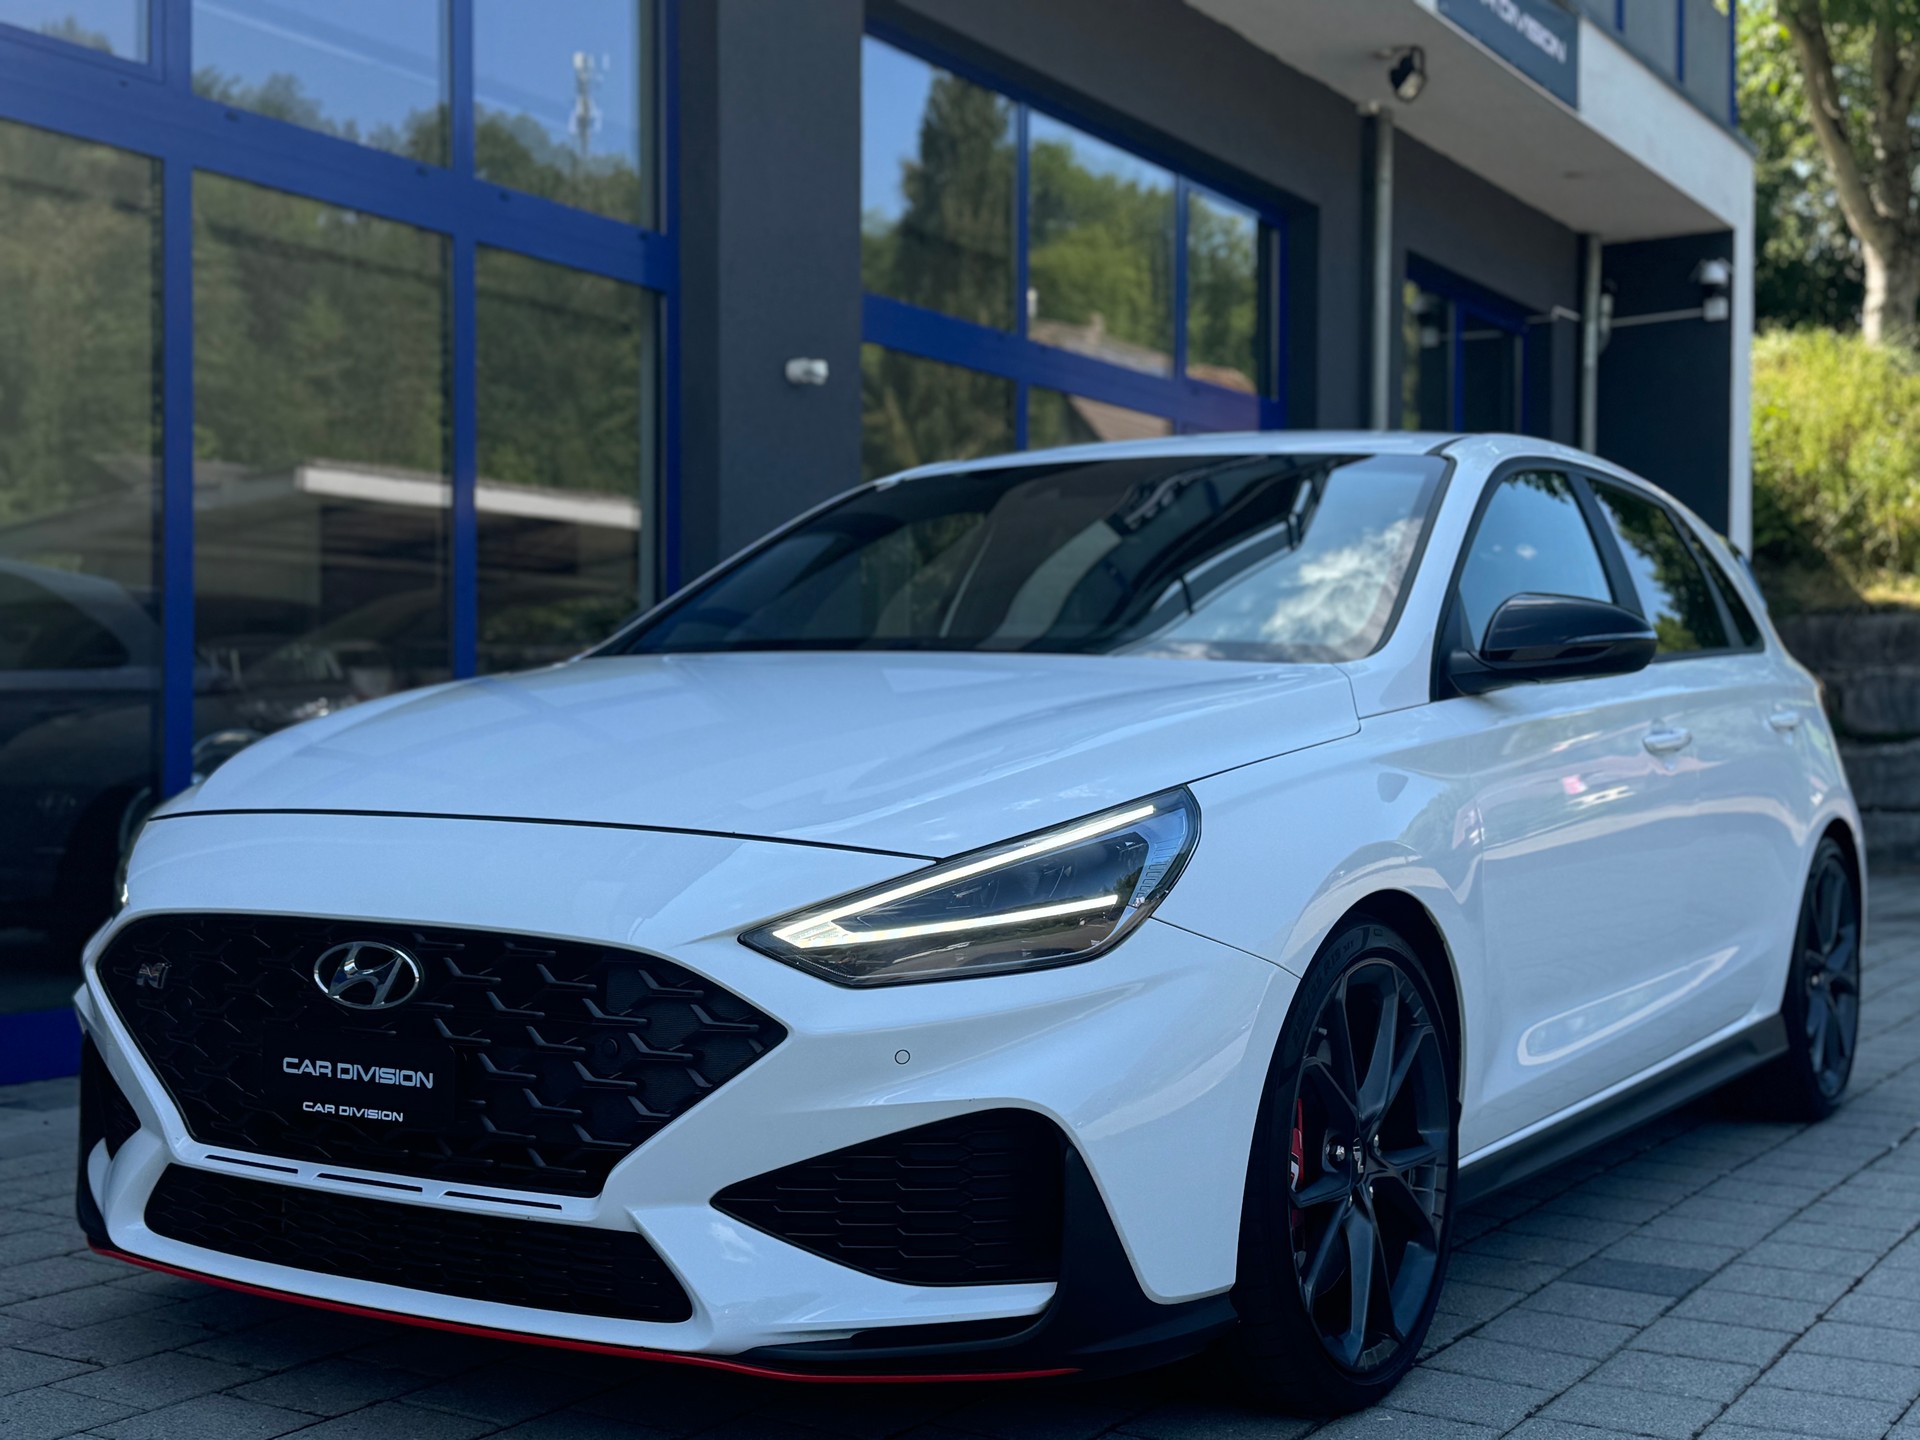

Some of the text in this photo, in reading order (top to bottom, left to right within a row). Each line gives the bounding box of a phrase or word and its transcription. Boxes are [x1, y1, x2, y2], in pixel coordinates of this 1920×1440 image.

[282, 1056, 434, 1089] CAR DIVISION
[302, 1101, 404, 1122] CAR DIVISION
